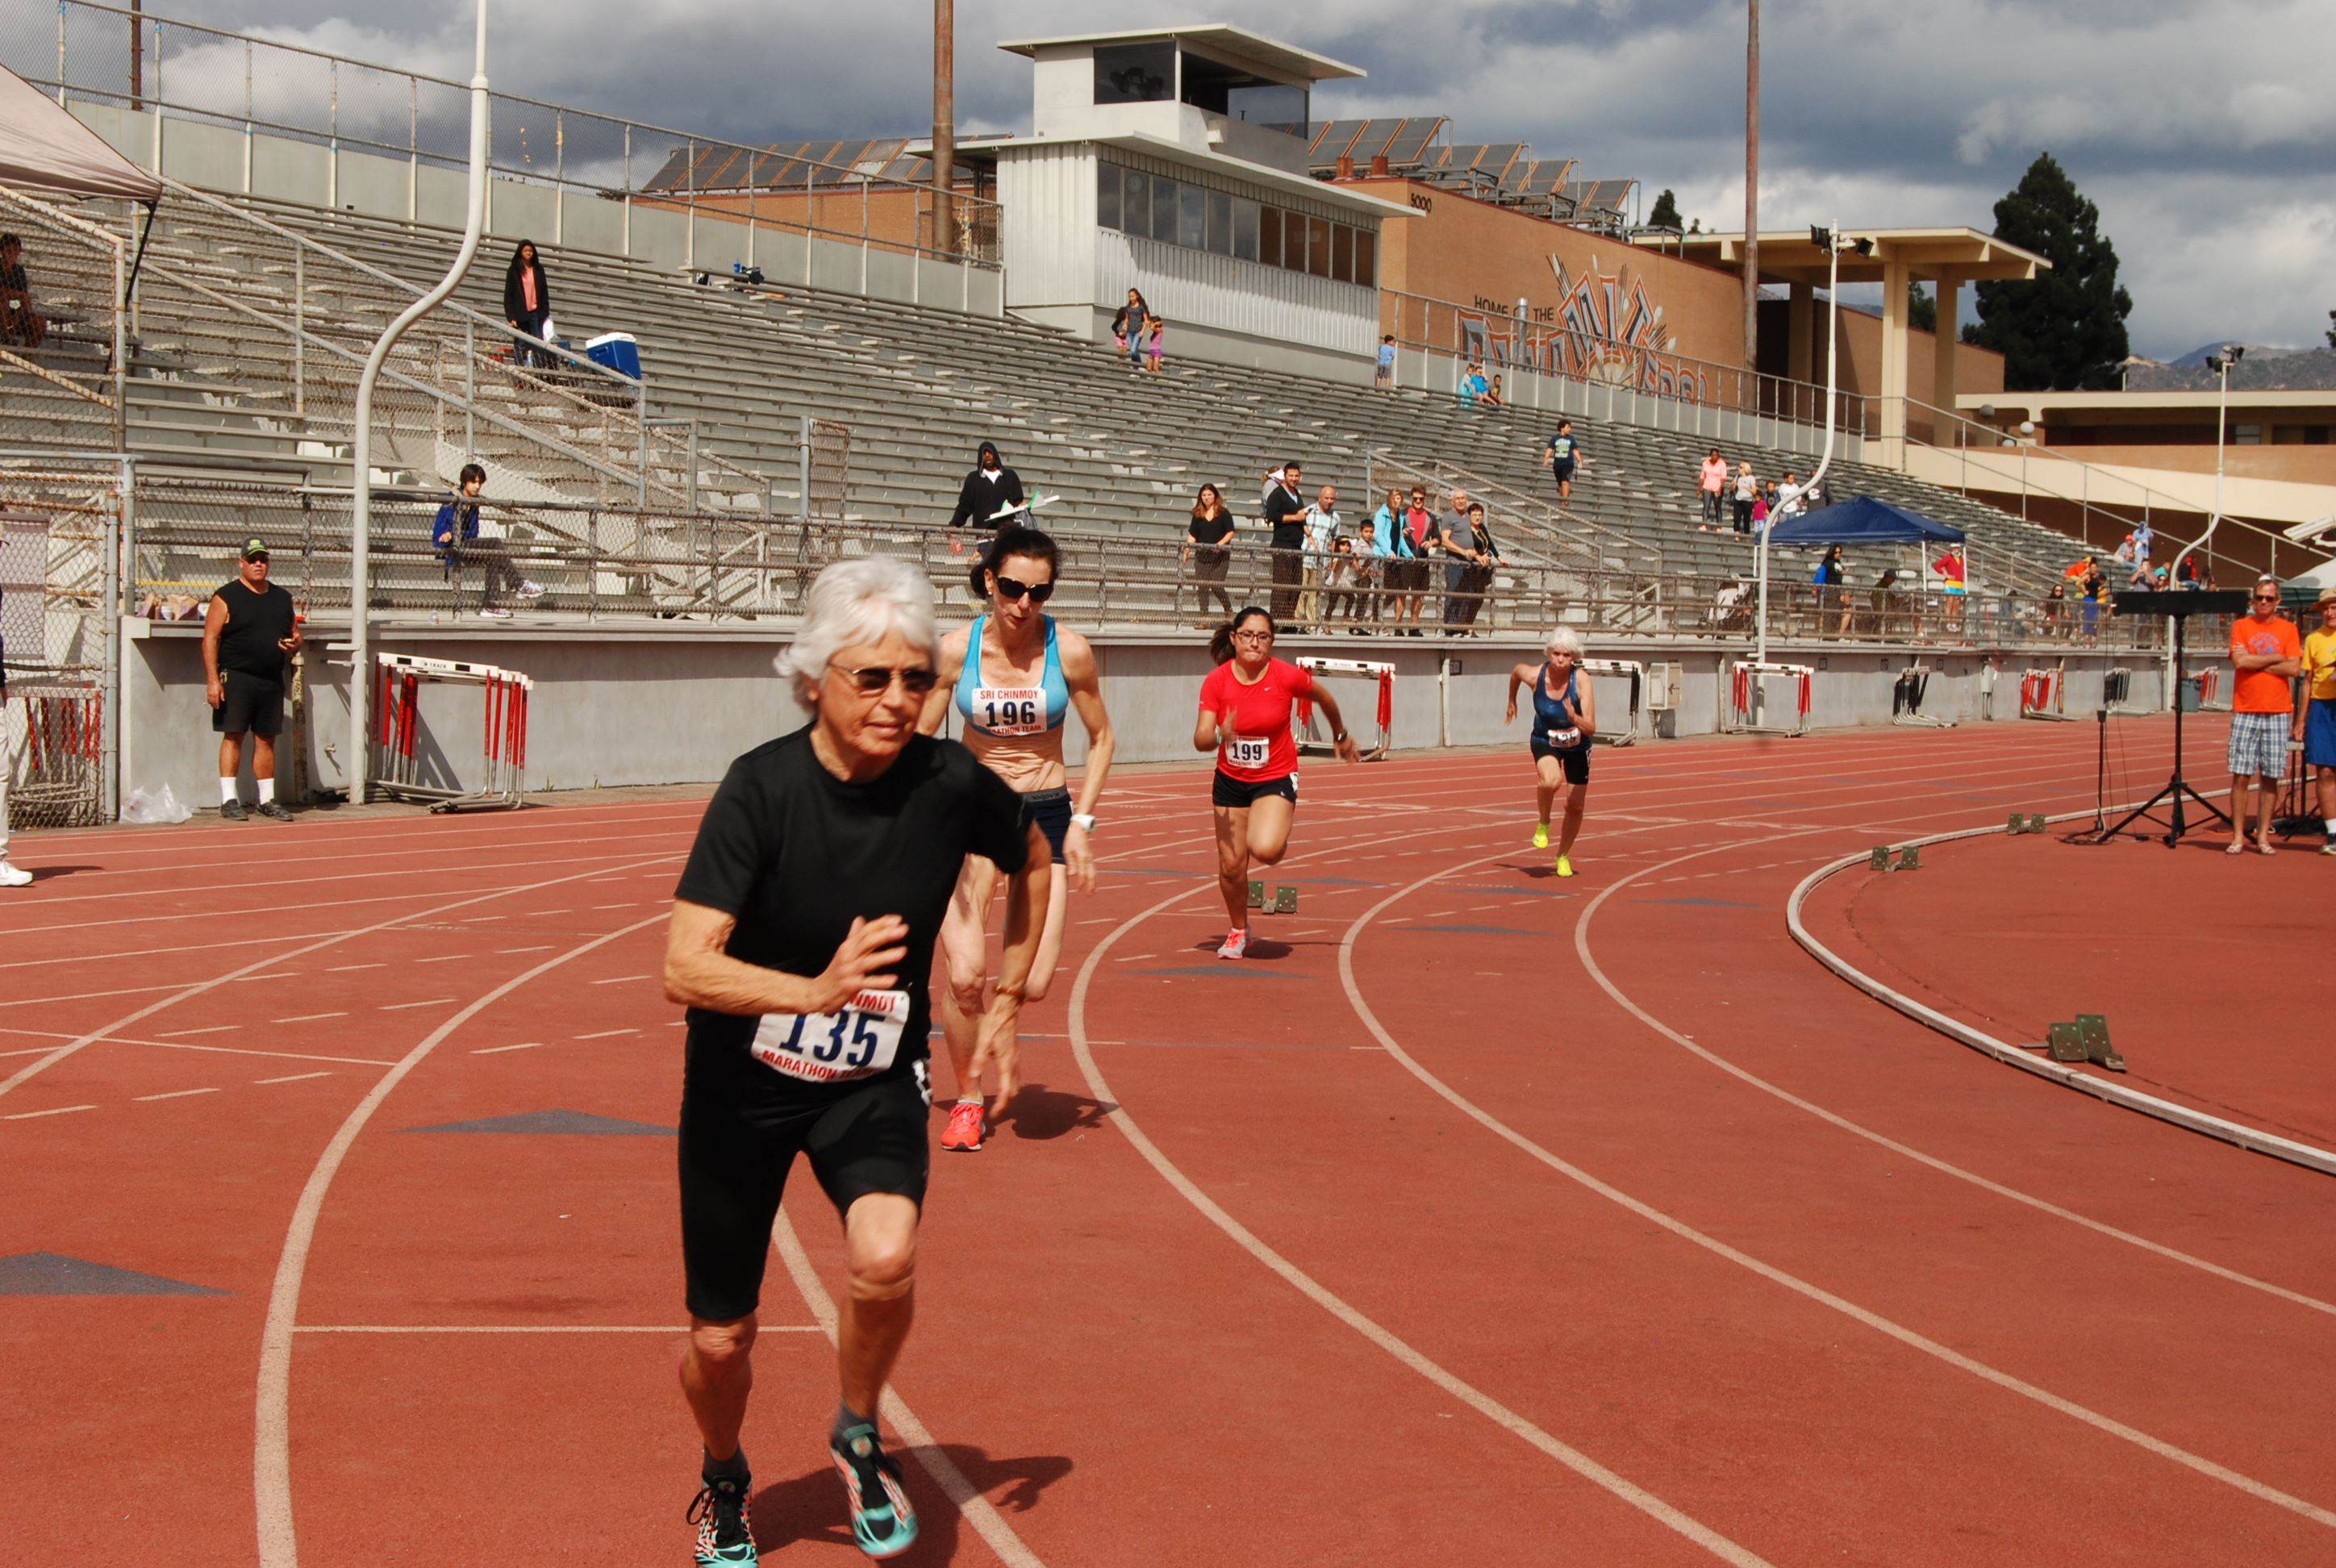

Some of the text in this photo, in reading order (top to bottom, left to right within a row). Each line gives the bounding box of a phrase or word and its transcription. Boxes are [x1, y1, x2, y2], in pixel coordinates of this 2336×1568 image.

[1475, 294, 1508, 316] HOME
[1533, 307, 1554, 323] THE
[981, 690, 1038, 699] SRI CHINMOY
[986, 702, 1036, 727] 196
[1233, 743, 1262, 761] 199
[778, 1009, 886, 1067] 135
[763, 1050, 837, 1079] MARATHON
